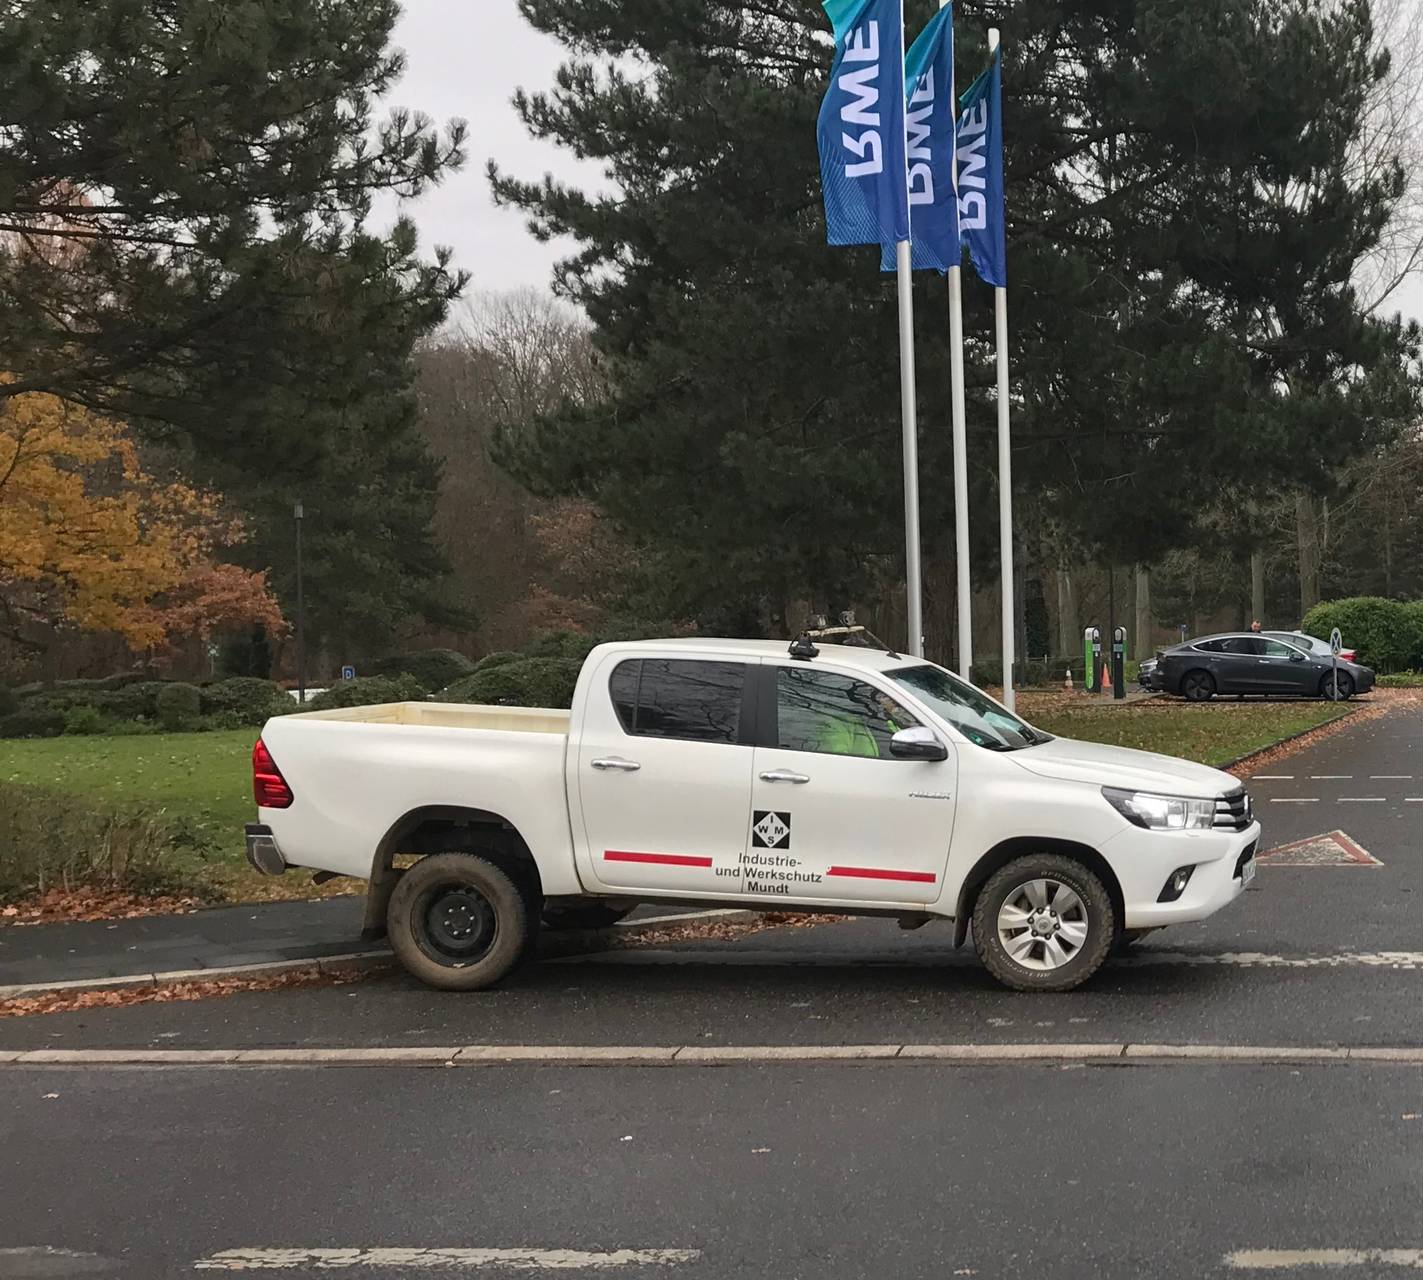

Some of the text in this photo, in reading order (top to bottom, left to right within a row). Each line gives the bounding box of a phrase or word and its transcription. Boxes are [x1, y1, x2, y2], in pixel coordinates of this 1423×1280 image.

[738, 852, 802, 867] Industrie-
[715, 866, 823, 883] und Werkschutz
[747, 881, 789, 894] Mundt
